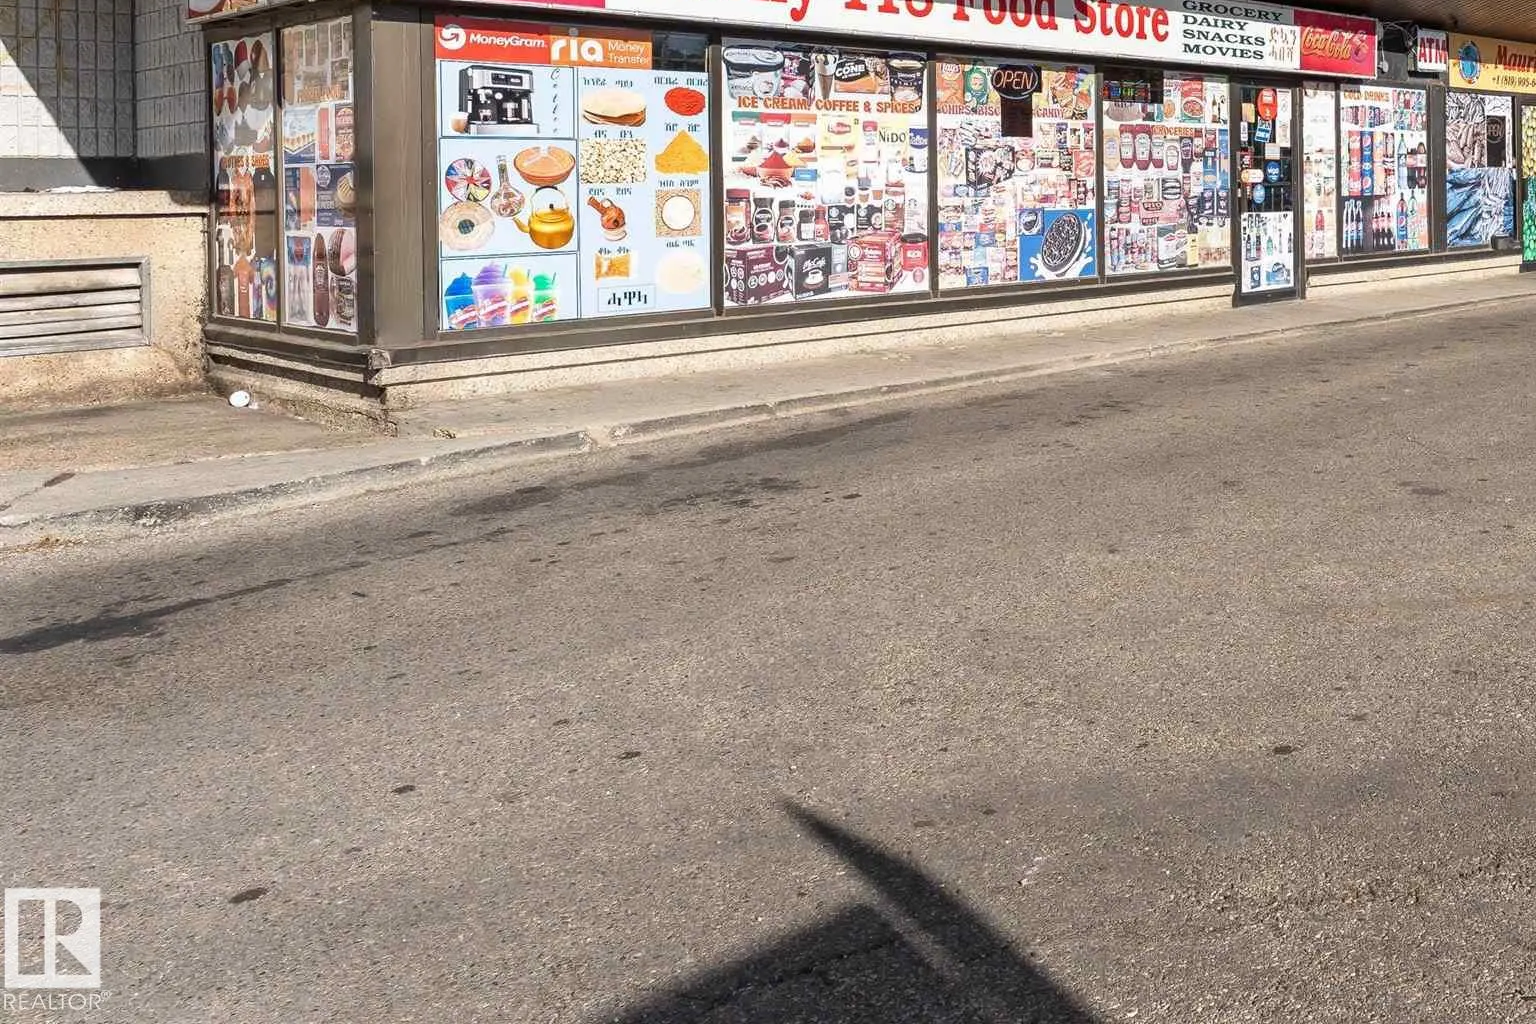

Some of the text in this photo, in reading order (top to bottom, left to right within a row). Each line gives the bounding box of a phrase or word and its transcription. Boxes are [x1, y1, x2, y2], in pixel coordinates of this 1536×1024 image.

[1182, 0, 1284, 22] GROCERY
[1182, 14, 1249, 31] DAIRY
[469, 32, 546, 47] MoneyGram
[1182, 28, 1266, 47] SNACKS
[551, 40, 604, 63] ria
[608, 41, 645, 53] Money
[1182, 43, 1265, 60] MOVIES
[1417, 36, 1448, 64] ATM
[608, 53, 651, 65] Transfer
[835, 64, 866, 77] CONE
[992, 69, 1034, 90] OPEN
[737, 96, 758, 108] ICE
[815, 99, 860, 112] COFFEE
[863, 101, 871, 112] &
[876, 101, 915, 114] SPICES
[1151, 124, 1193, 137] GROCERIES
